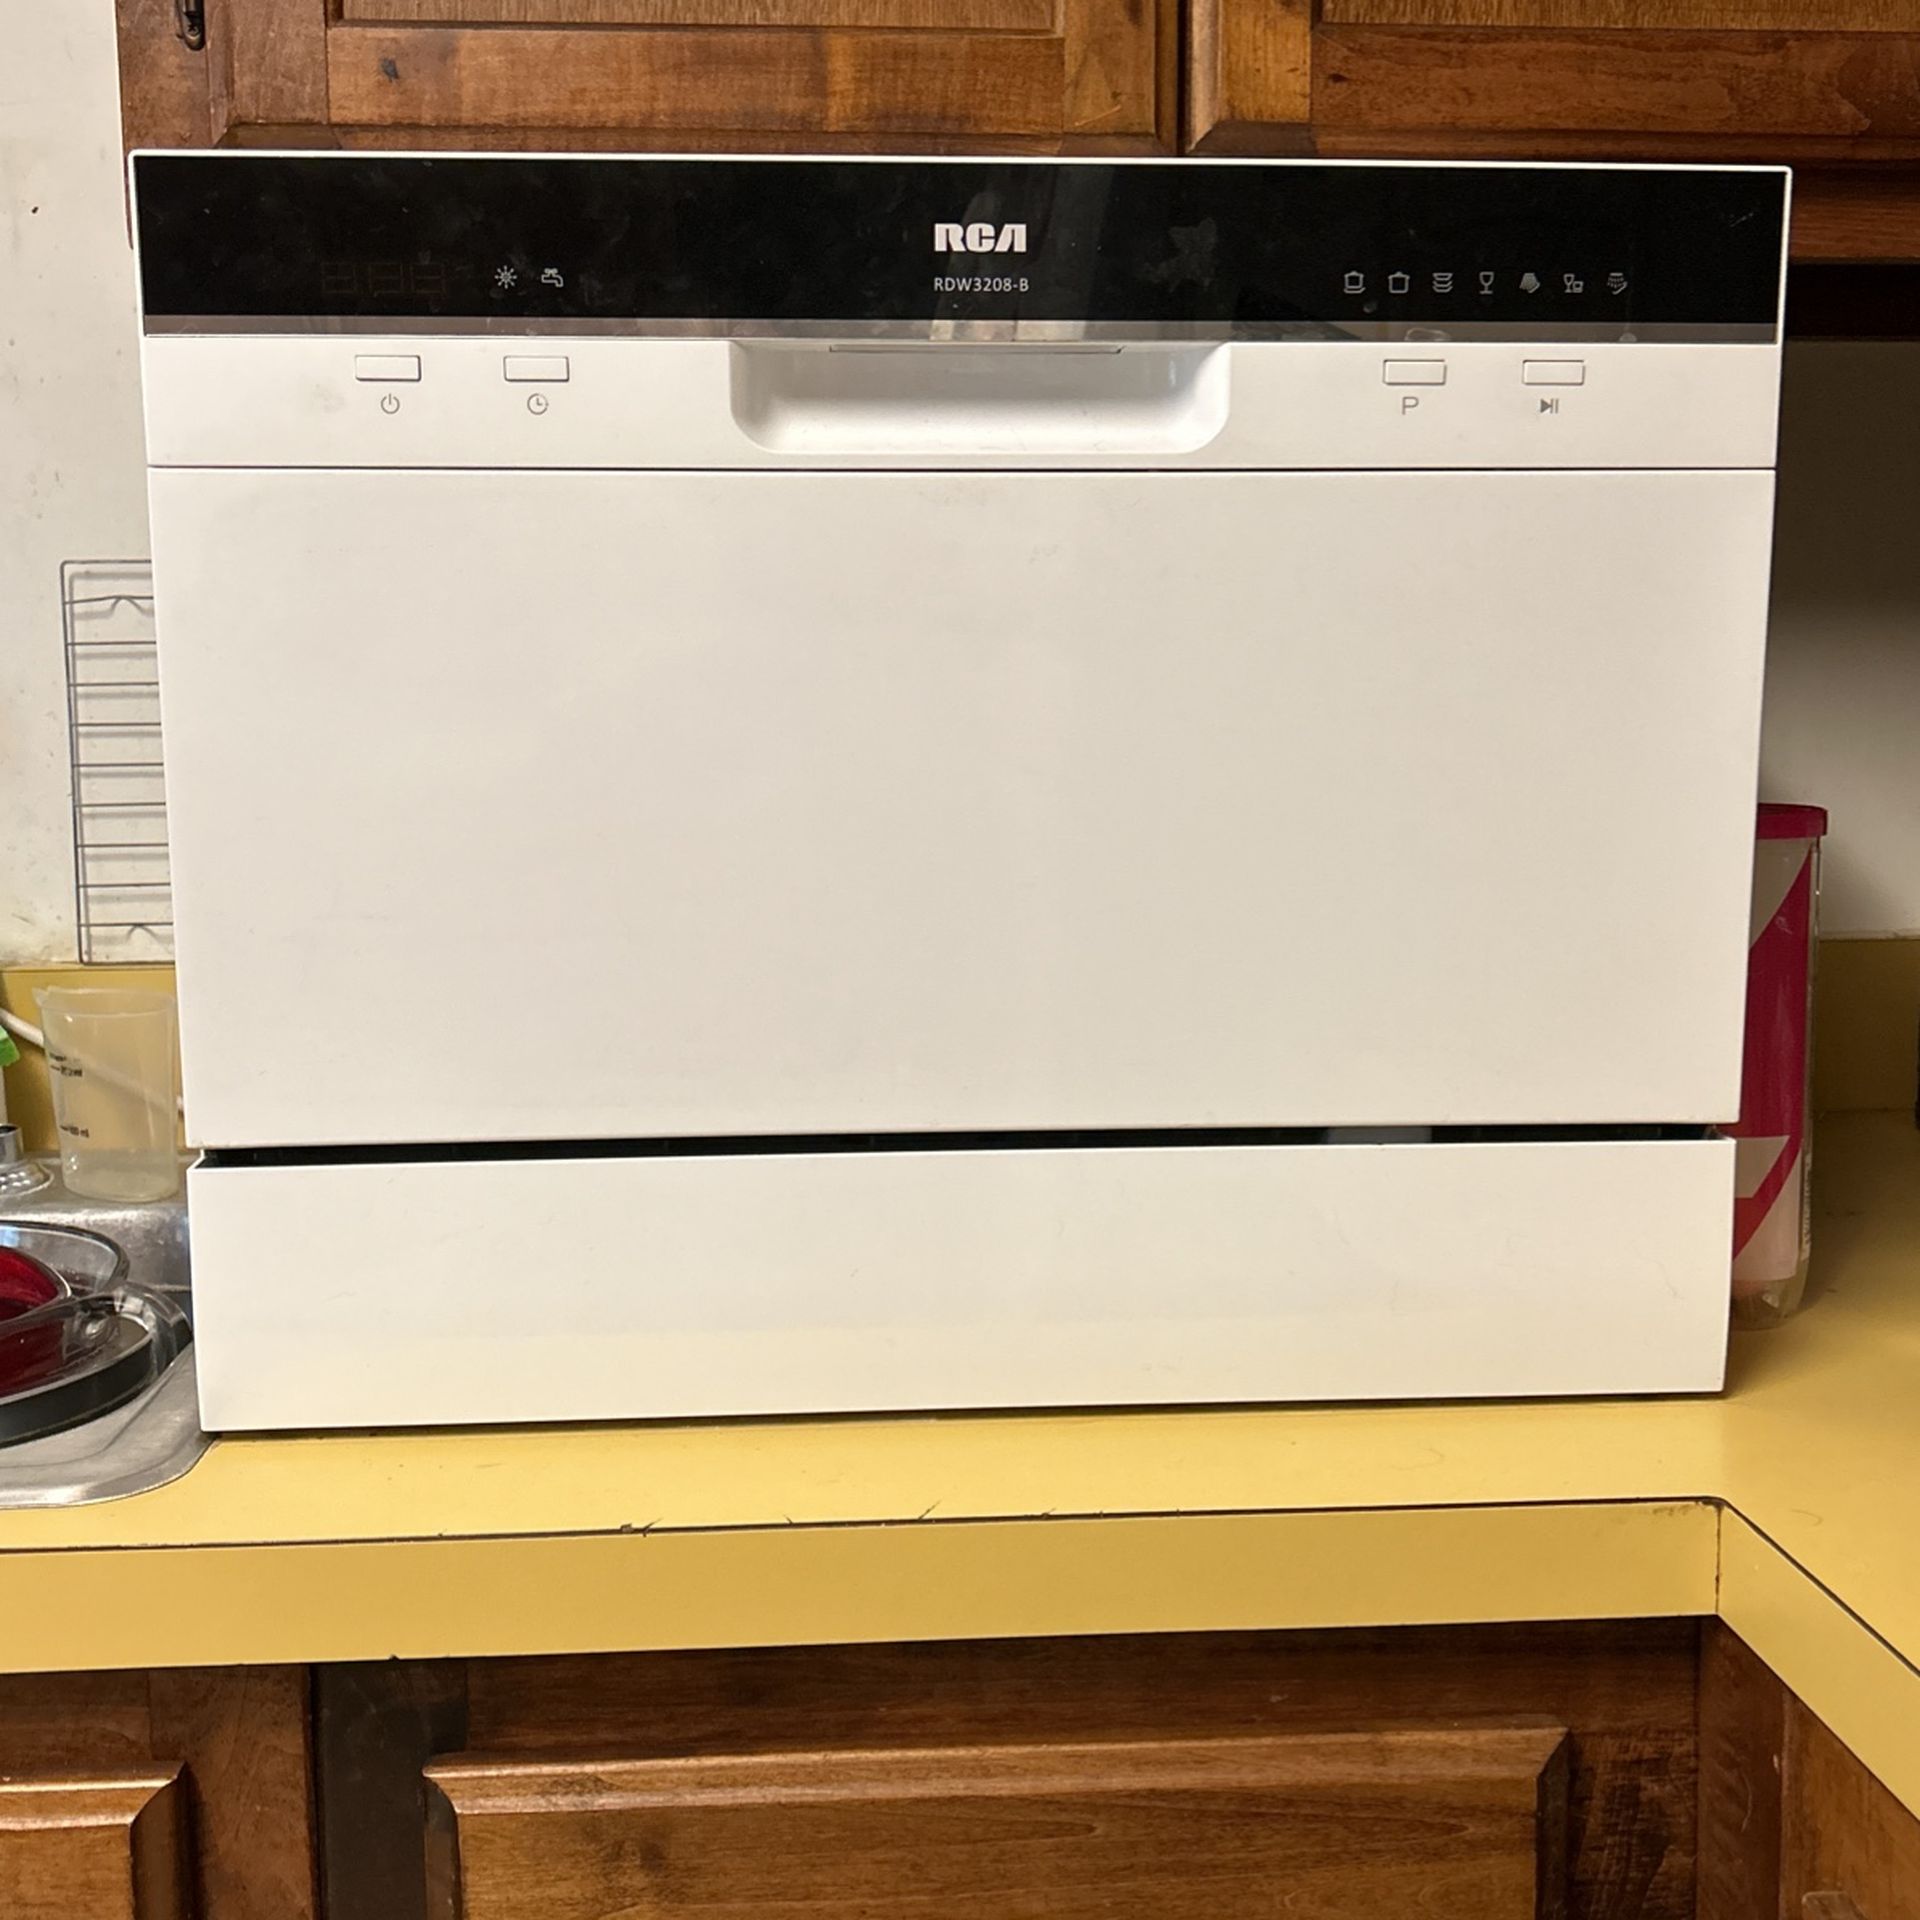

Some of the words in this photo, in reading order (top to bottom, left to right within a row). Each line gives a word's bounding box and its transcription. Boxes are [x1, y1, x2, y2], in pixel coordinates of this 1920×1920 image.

[934, 223, 1027, 252] RCA
[934, 277, 1029, 292] RDW3208-B
[1402, 396, 1420, 415] P
